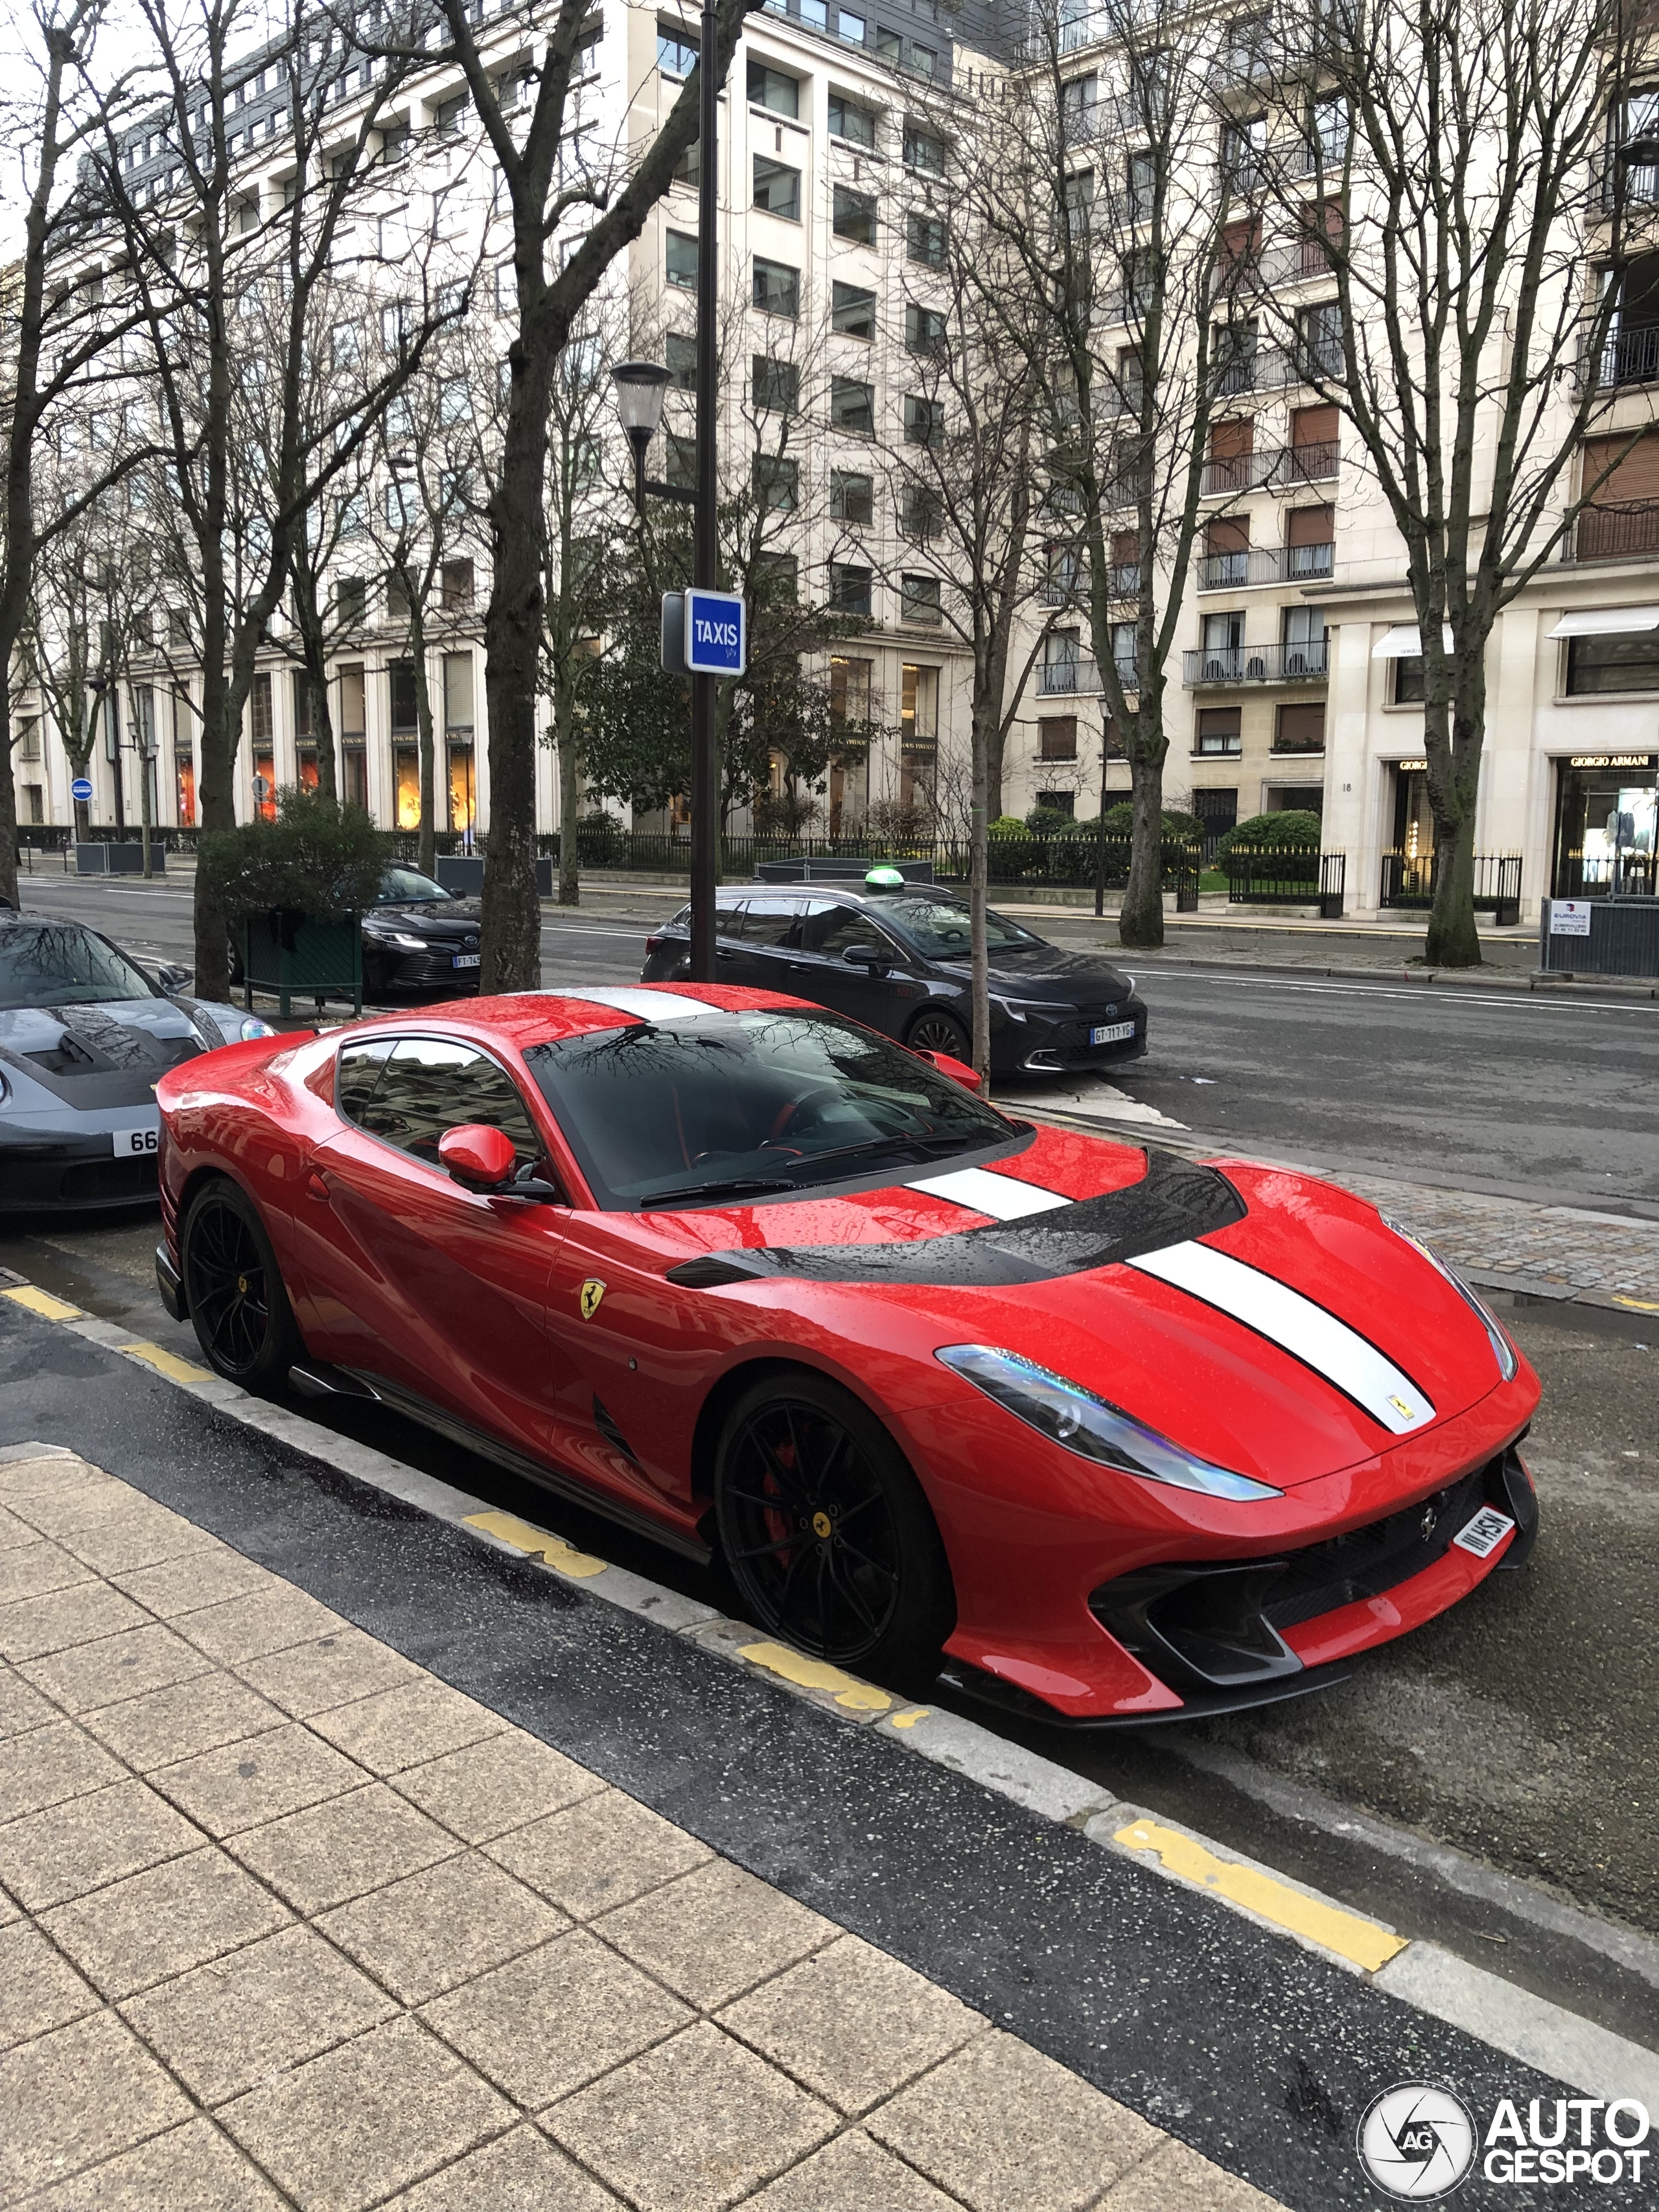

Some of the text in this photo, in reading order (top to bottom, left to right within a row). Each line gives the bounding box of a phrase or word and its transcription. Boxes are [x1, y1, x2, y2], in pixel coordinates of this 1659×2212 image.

[695, 619, 737, 646] TAXIS
[1400, 761, 1428, 770] GIORGI
[1571, 756, 1649, 767] GIORGIO ARMANI
[1343, 783, 1351, 792] 18
[1096, 1024, 1130, 1042] GT-717-YG
[131, 1131, 157, 1151] 66
